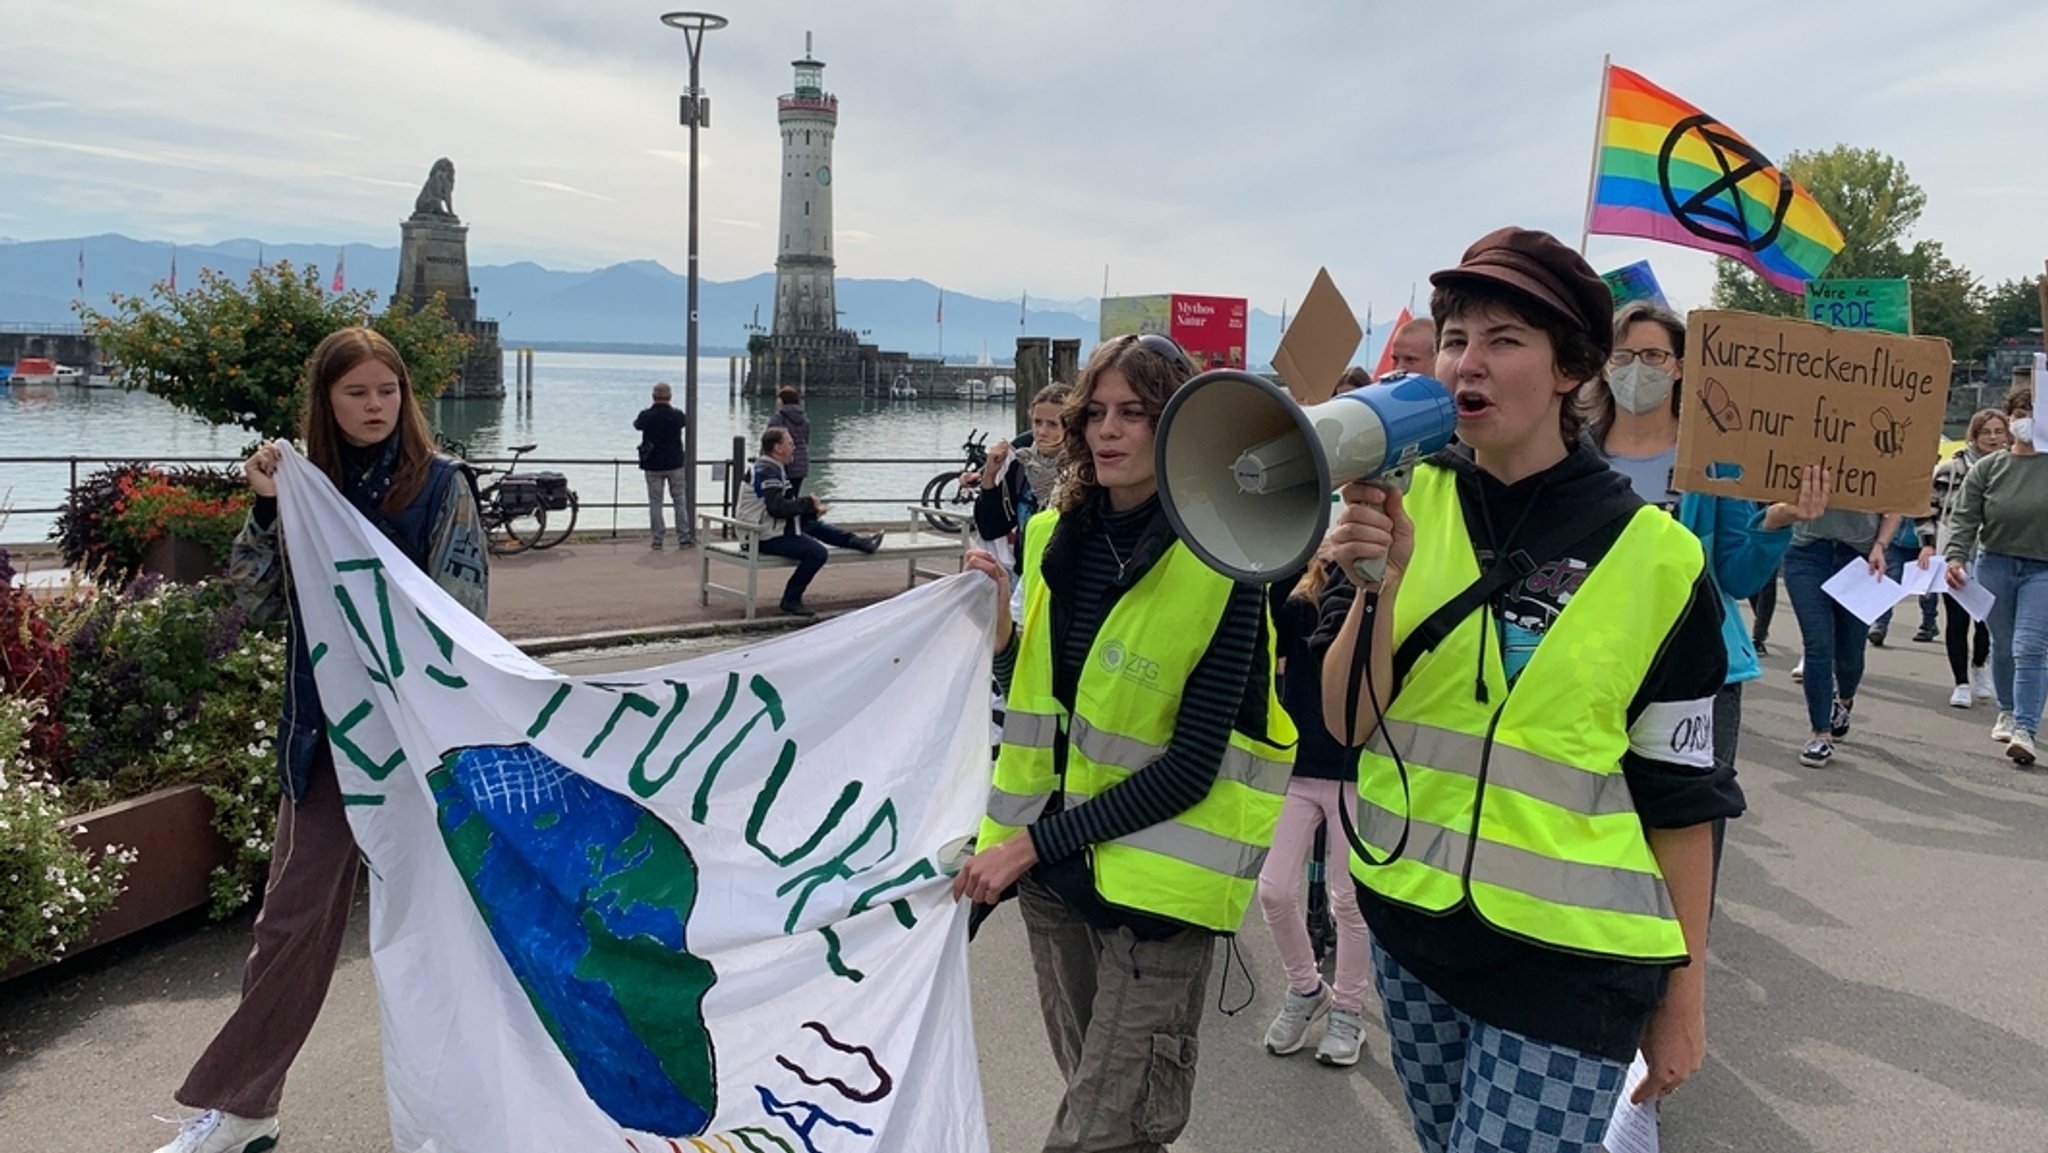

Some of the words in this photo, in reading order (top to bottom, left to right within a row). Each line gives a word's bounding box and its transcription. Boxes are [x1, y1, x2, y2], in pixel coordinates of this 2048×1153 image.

[1176, 301, 1216, 316] Mythos
[1176, 314, 1207, 327] Natur
[1813, 300, 1878, 328] ERDE
[1701, 323, 1934, 403] Kurzstreckenflüge
[1748, 406, 1795, 437] nur
[1813, 394, 1857, 445] für
[1764, 448, 1878, 497] Inskten
